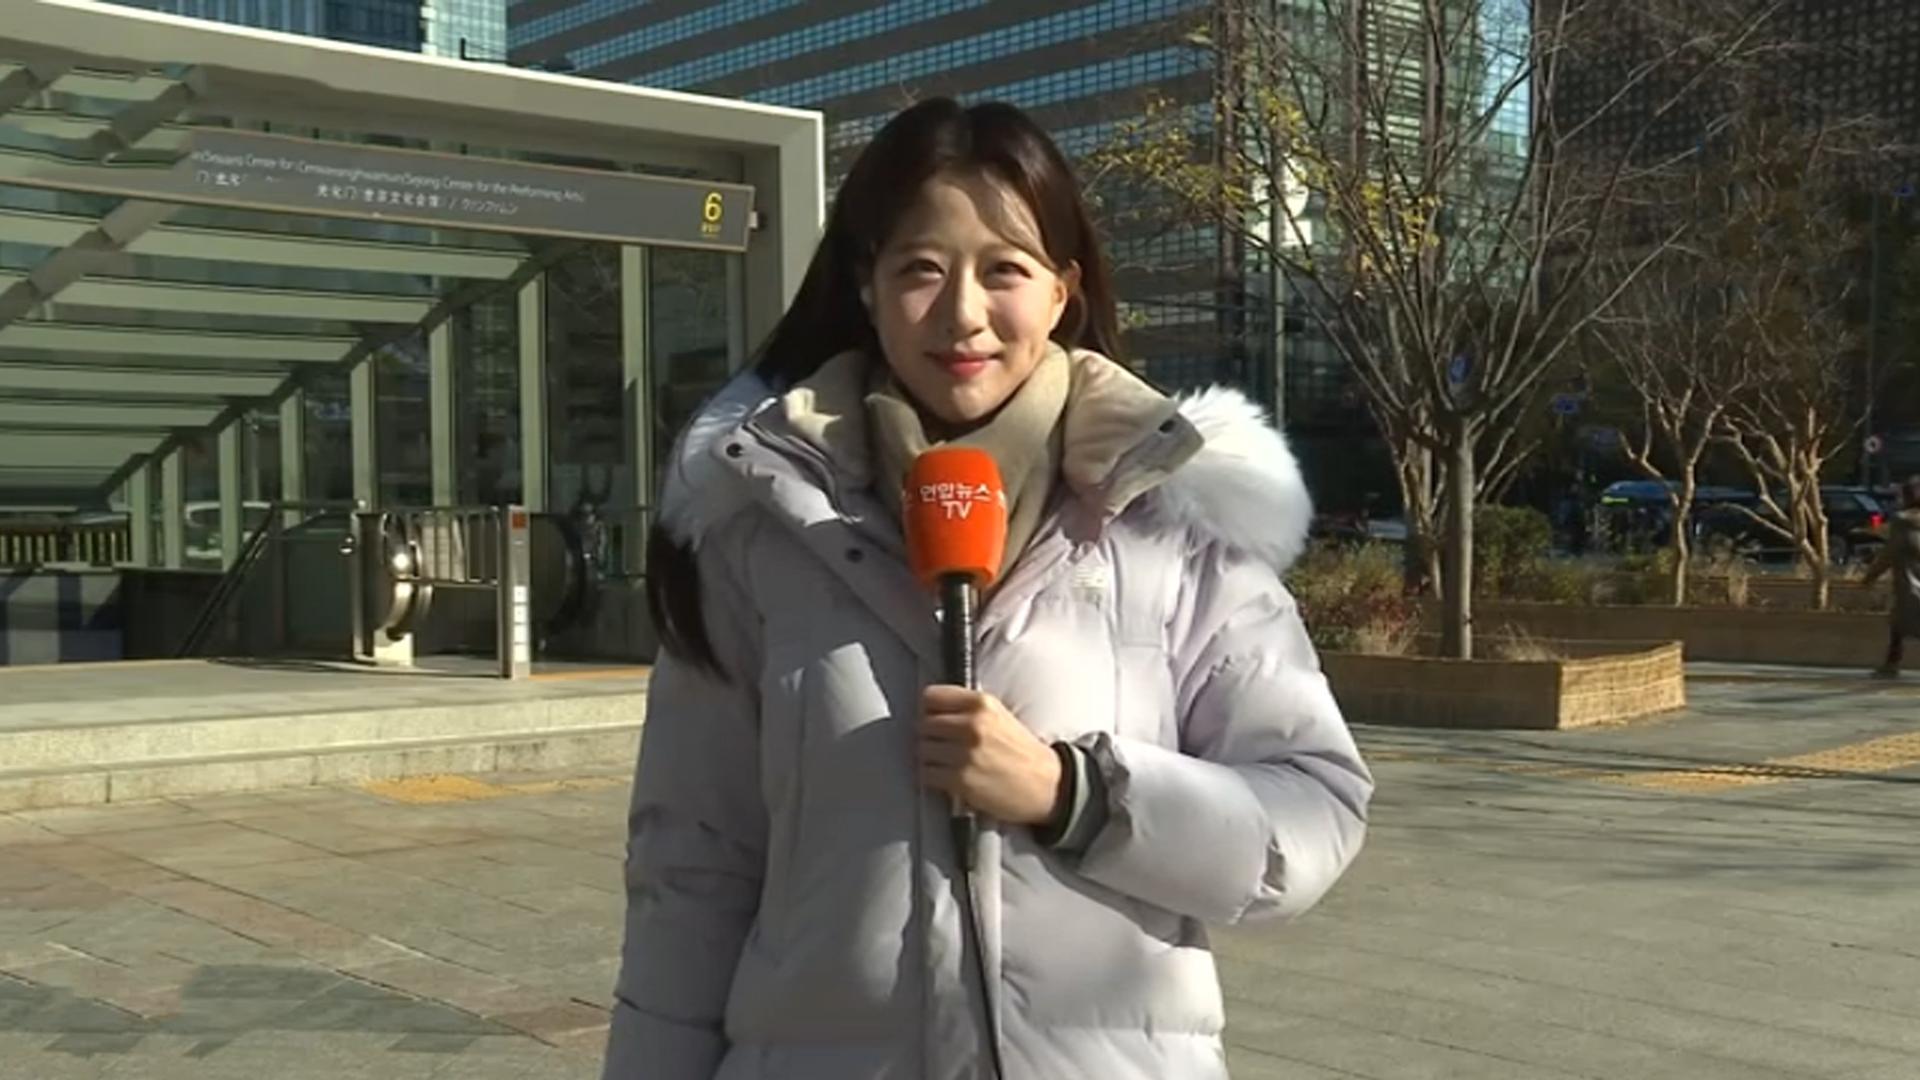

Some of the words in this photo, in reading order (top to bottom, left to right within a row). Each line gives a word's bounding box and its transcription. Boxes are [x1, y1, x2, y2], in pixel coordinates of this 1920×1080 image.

[705, 192, 722, 221] 6
[920, 482, 992, 502] 연합뉴스
[941, 500, 973, 519] TV
